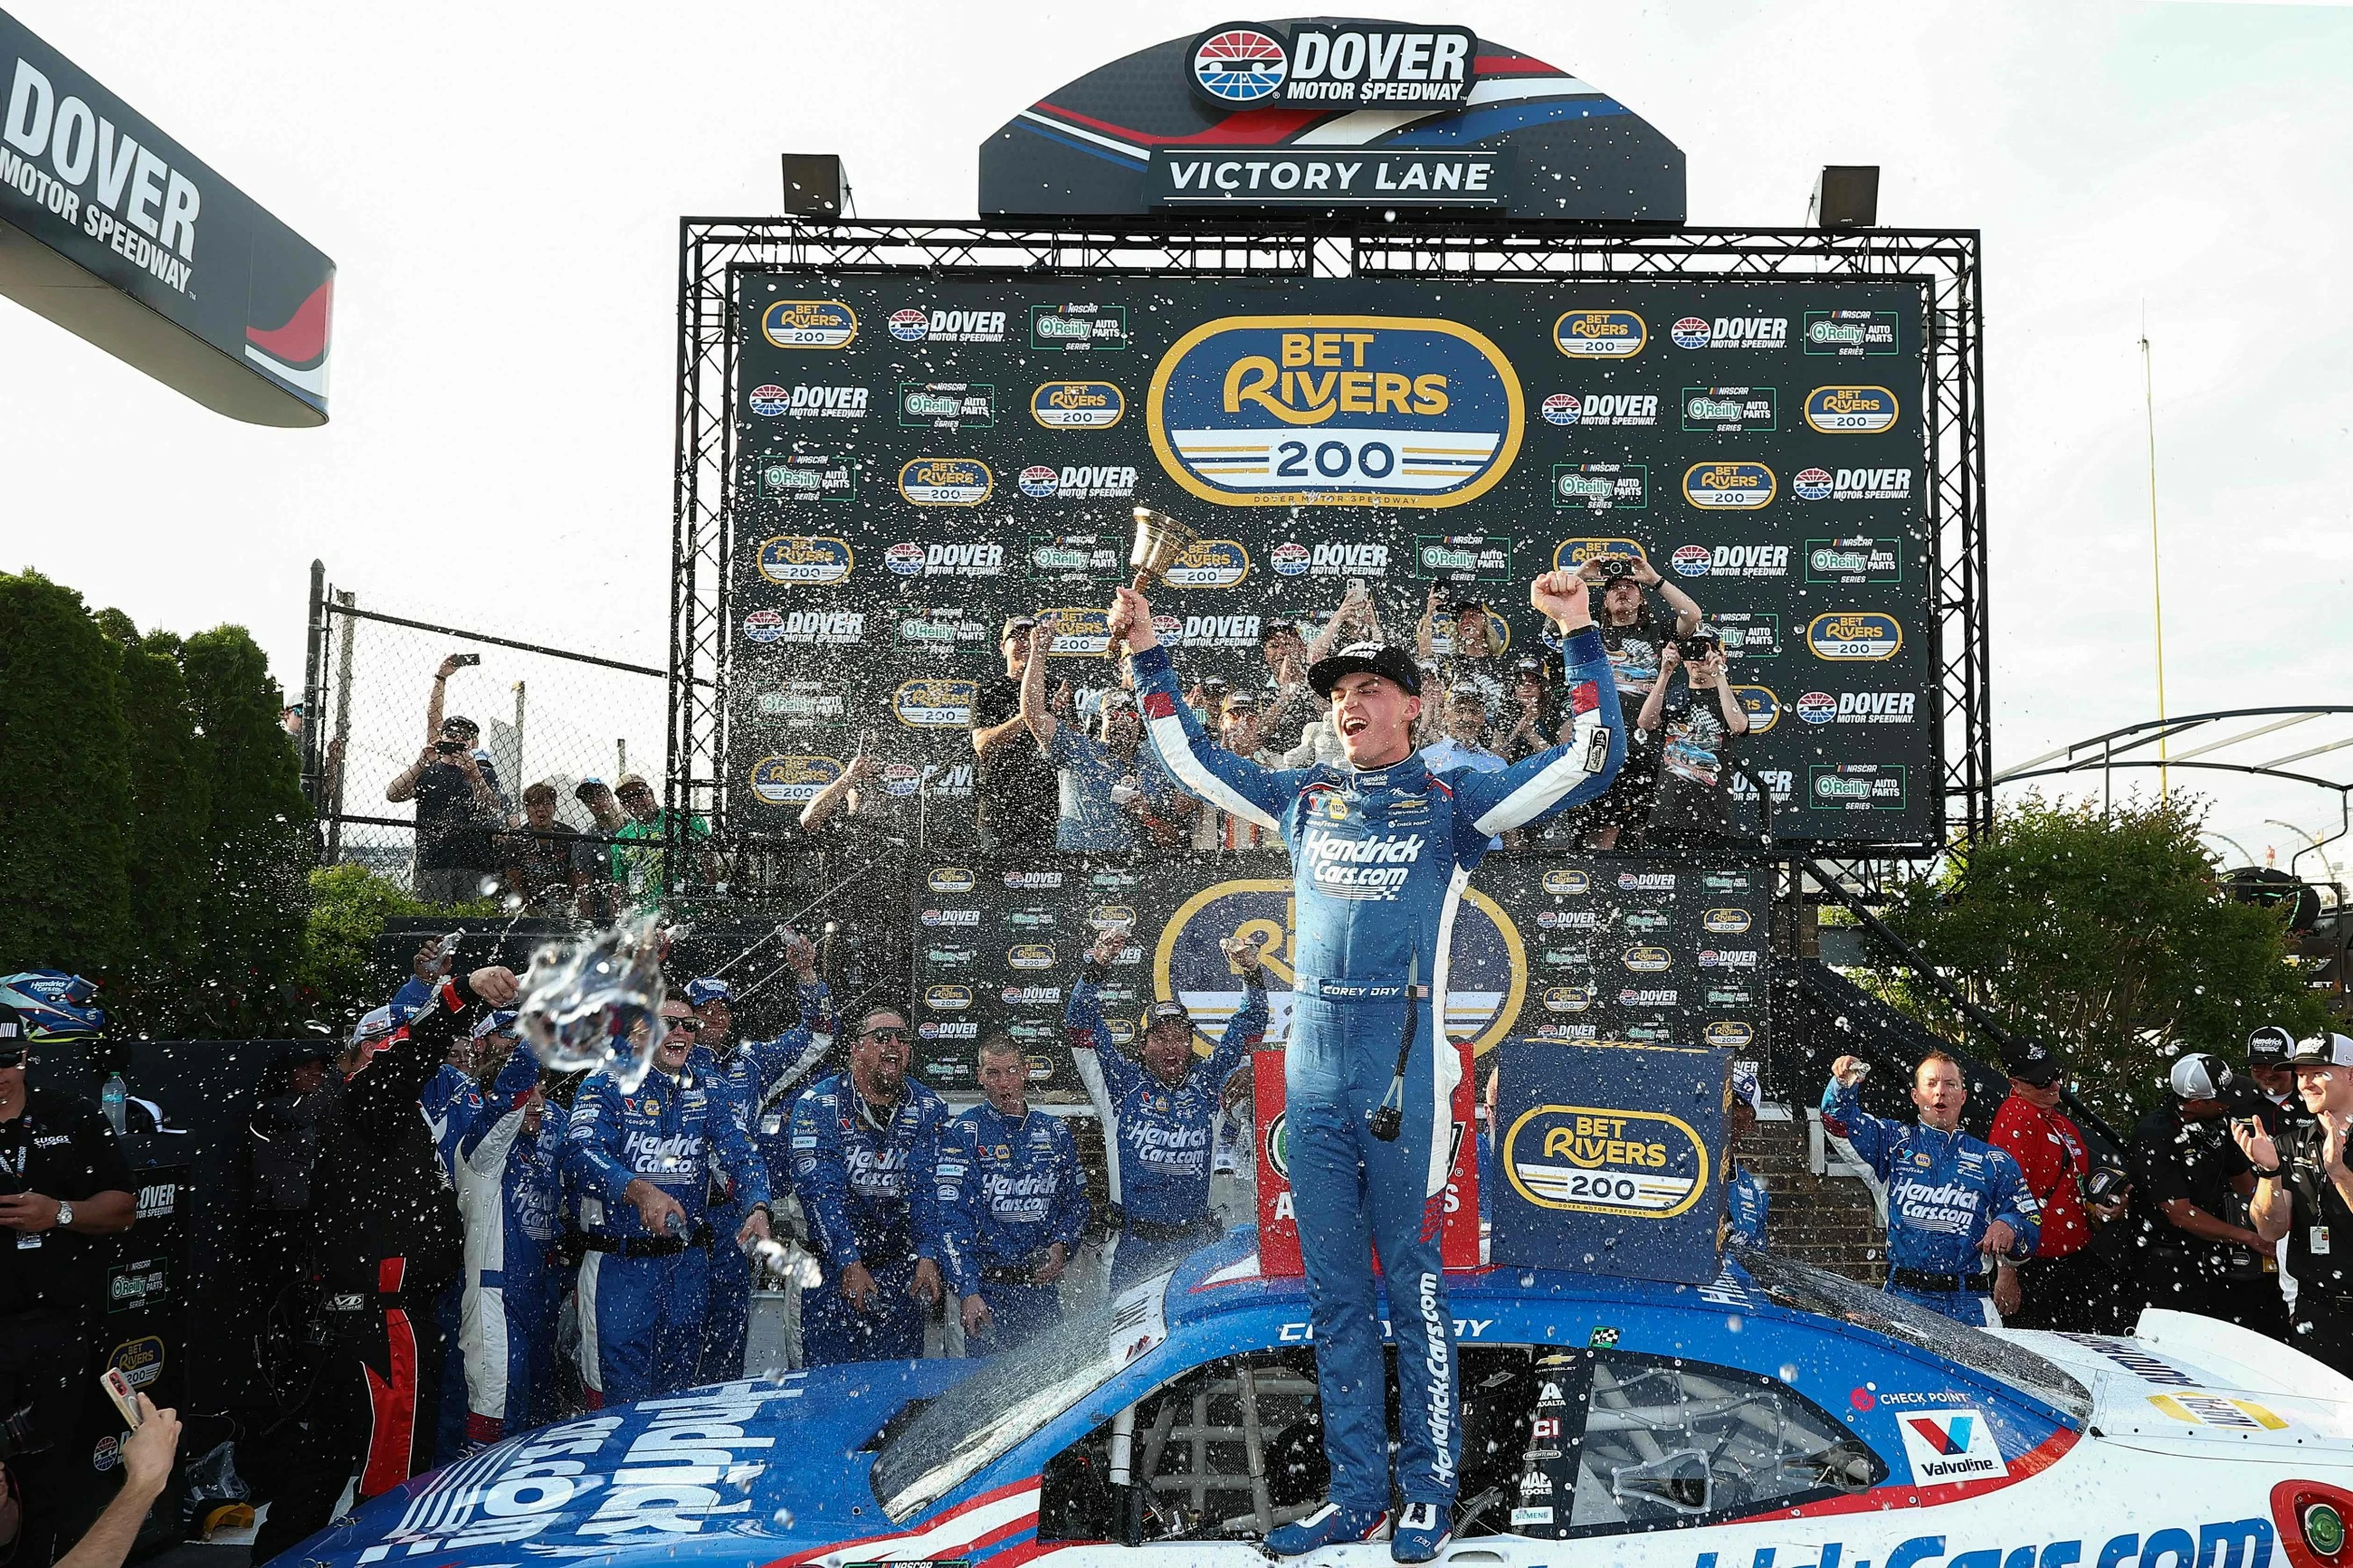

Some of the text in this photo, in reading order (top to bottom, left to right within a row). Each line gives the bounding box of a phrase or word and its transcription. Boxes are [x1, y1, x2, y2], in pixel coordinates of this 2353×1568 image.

[1289, 33, 1471, 81] DOVER
[1287, 81, 1461, 100] MOTOR SPEEDWAY
[4, 56, 201, 262] DOVER
[1169, 161, 1490, 192] VICTORY LANE
[0, 147, 192, 294] MOTOR SPEEDWAY
[795, 305, 819, 315] BET
[781, 310, 838, 329] RIVERS
[929, 310, 1006, 333] DOVER
[1096, 320, 1117, 328] AUTO
[1586, 315, 1609, 324] BET
[1093, 329, 1119, 337] PARTS
[1573, 320, 1628, 337] RIVERS
[1712, 318, 1787, 338] DOVER
[1812, 322, 1864, 343] O'Reilly
[1869, 326, 1890, 334] AUTO
[795, 333, 824, 342] 200
[928, 333, 1003, 342] MOTOR SPEEDWAY
[1866, 335, 1892, 343] PARTS
[1281, 333, 1375, 367] BET
[1586, 342, 1615, 350] 200
[1741, 340, 1785, 348] SPEEDWAY
[1223, 355, 1449, 425] RIVERS
[1837, 391, 1861, 399] BET
[791, 385, 868, 409] DOVER
[1050, 391, 1106, 409] RIVERS
[1583, 394, 1658, 416] DOVER
[1690, 399, 1741, 419] O'Reilly
[1824, 395, 1880, 413] RIVERS
[789, 408, 865, 418] MOTOR SPEEDWAY
[1063, 413, 1092, 422] 200
[1581, 417, 1655, 425] MOTOR SPEEDWAY
[1837, 417, 1866, 426] 200
[1276, 441, 1395, 479] 200
[1060, 466, 1135, 487] DOVER
[1716, 467, 1739, 475] BET
[1617, 479, 1638, 487] AUTO
[1701, 471, 1758, 489] RIVERS
[1834, 469, 1911, 490] DOVER
[1615, 488, 1641, 496] PARTS
[1715, 493, 1744, 502] 200
[1833, 491, 1908, 499] MOTOR SPEEDWAY
[1254, 496, 1297, 504] DOVER
[1350, 496, 1417, 504] SPEEDWAY
[1586, 543, 1609, 551] BET
[1843, 538, 1873, 546] NASCAR
[927, 544, 1004, 566] DOVER
[1312, 544, 1389, 566] DOVER
[1713, 546, 1788, 566] DOVER
[1871, 553, 1893, 561] AUTO
[1478, 560, 1504, 568] PARTS
[1868, 562, 1895, 570] PARTS
[1188, 572, 1217, 581] 200
[1742, 568, 1786, 576] SPEEDWAY
[786, 611, 863, 633] DOVER
[1184, 615, 1261, 637] DOVER
[1841, 618, 1863, 626] BET
[1748, 628, 1770, 636] AUTO
[1826, 622, 1882, 641] RIVERS
[1746, 637, 1772, 645] PARTS
[1840, 644, 1869, 653] 200
[1838, 692, 1915, 714] DOVER
[1836, 715, 1911, 723] MOTOR SPEEDWAY
[1847, 765, 1878, 773] NASCAR
[1359, 774, 1389, 784] Hendrick
[1875, 779, 1897, 787] AUTO
[1817, 776, 1871, 797] O'Reilly
[1872, 788, 1900, 796] PARTS
[1332, 803, 1344, 813] NAPA
[1304, 829, 1424, 866] Hendrick
[1024, 872, 1062, 883] DOVER
[1314, 860, 1409, 886] Cars.com
[1638, 874, 1676, 885] DOVER
[941, 910, 980, 921] DOVER
[1321, 984, 1401, 996] COREY DAY
[1639, 990, 1678, 1001] DOVER
[939, 1022, 977, 1034] DOVER
[1577, 1117, 1627, 1139] BET
[33, 1135, 69, 1145] SUGGS
[1544, 1126, 1667, 1168] RIVERS
[1139, 1145, 1205, 1164] Cars.com
[1917, 1156, 1930, 1164] NAPA
[983, 1174, 1058, 1202] Hendrick
[1571, 1176, 1635, 1201] 200
[1891, 1177, 1979, 1211] Hendrick
[137, 1183, 176, 1210] OVER
[992, 1195, 1051, 1212] Cars.com
[148, 1205, 174, 1218] SPEEDWAY
[1610, 1208, 1646, 1216] SPEEDWAY
[1902, 1201, 1974, 1225] Cars.com
[130, 1259, 151, 1269] NASCAR
[148, 1273, 163, 1282] AUTO
[111, 1276, 146, 1298] O'Reilly
[147, 1280, 163, 1291] PARTS
[129, 1300, 146, 1309] SERIES
[129, 1342, 143, 1355] BET
[119, 1350, 154, 1369] RIVERS
[127, 1371, 146, 1383] 200
[1417, 1272, 1454, 1488] HendrickCars.com
[1881, 1391, 1967, 1405] CHECK POINT
[1534, 1420, 1558, 1437] CI
[1920, 1458, 1994, 1477] Valvoline
[444, 1415, 624, 1549] ars.com
[1520, 1471, 1552, 1489] MAC
[1520, 1487, 1552, 1496] TOOLS
[1515, 1512, 1548, 1520] SIEMENS
